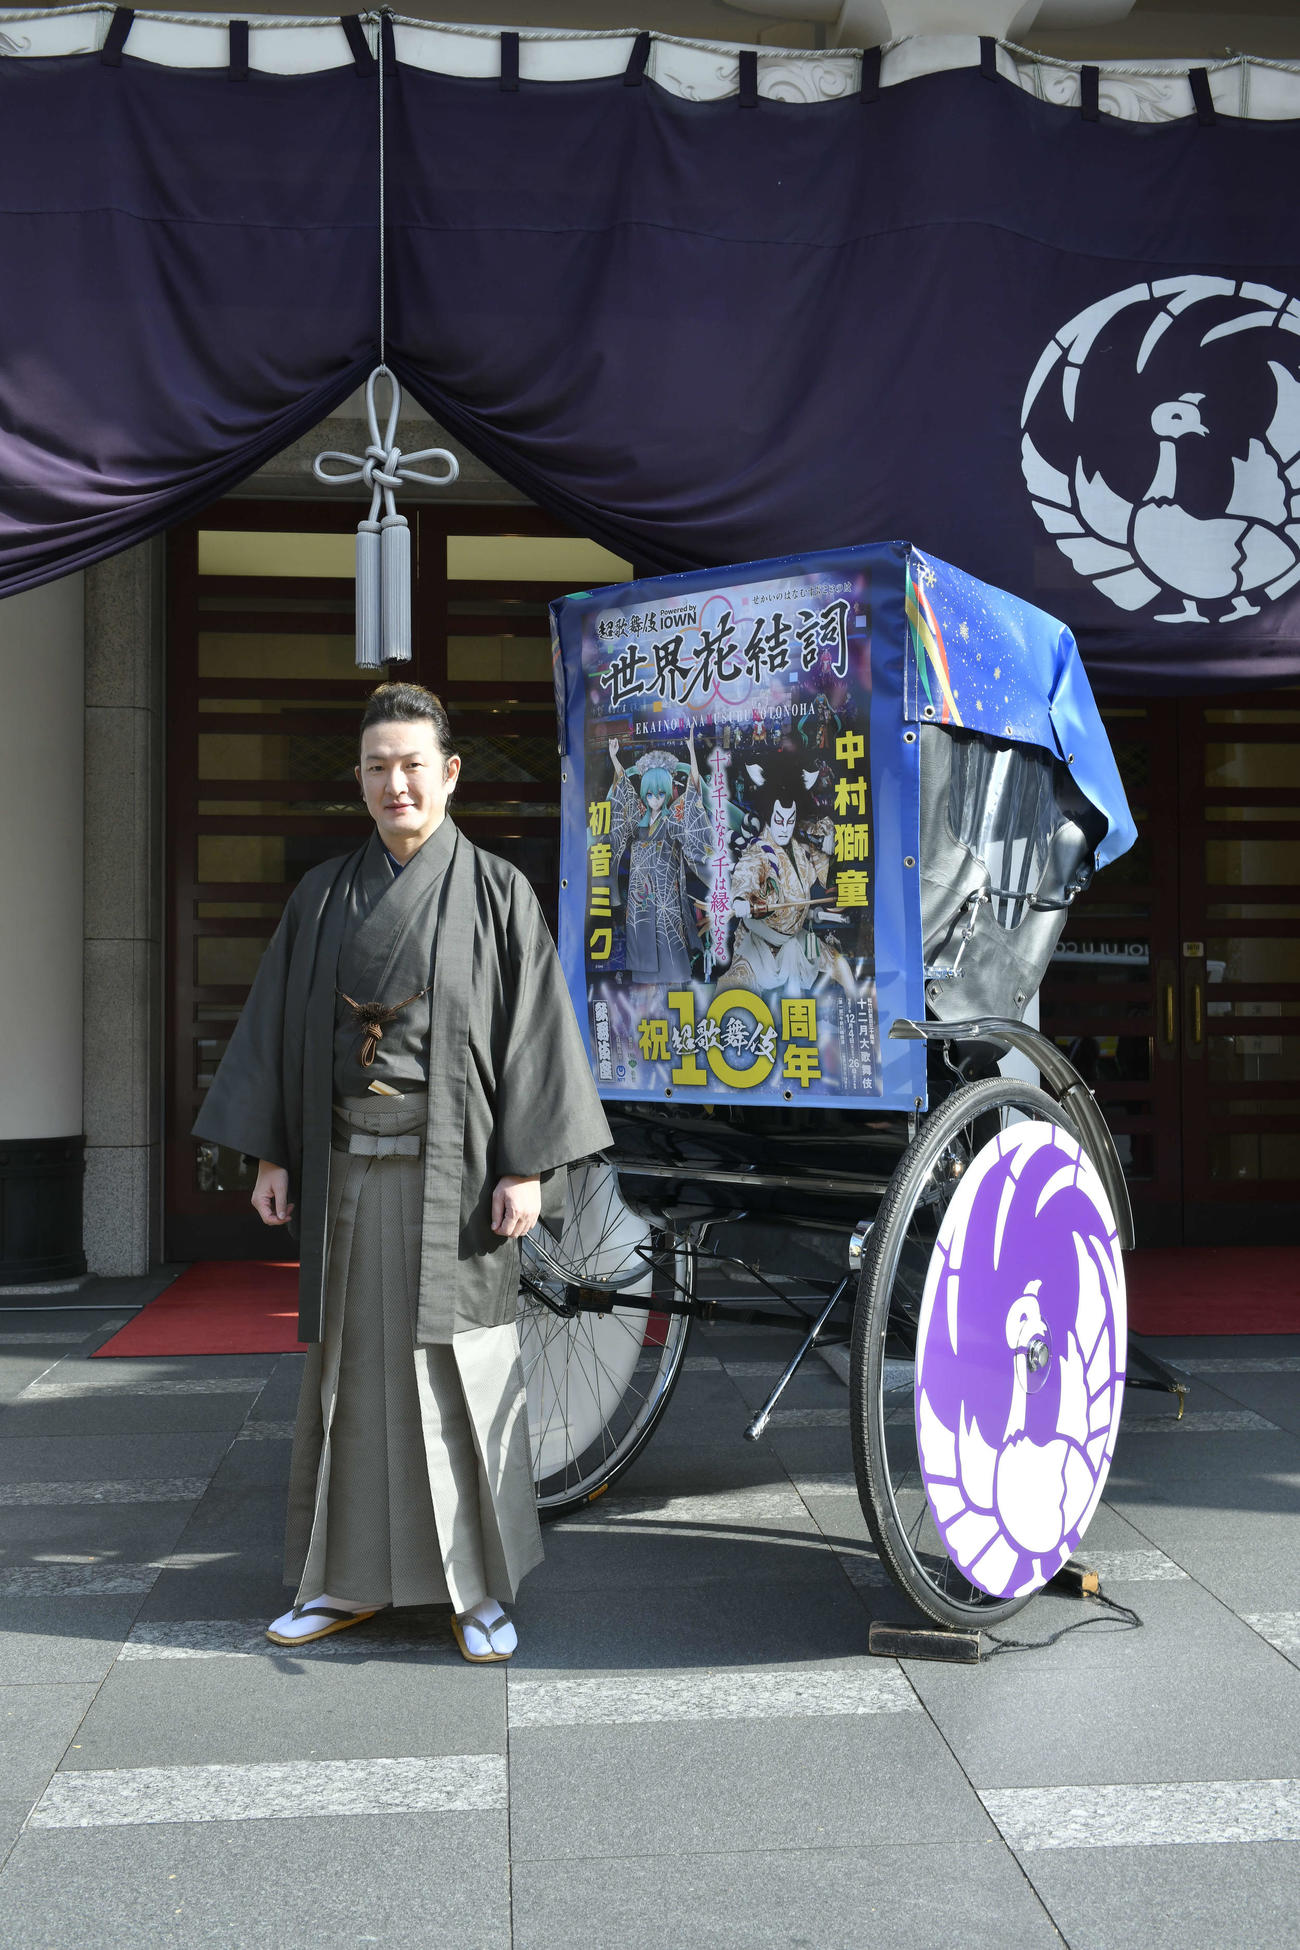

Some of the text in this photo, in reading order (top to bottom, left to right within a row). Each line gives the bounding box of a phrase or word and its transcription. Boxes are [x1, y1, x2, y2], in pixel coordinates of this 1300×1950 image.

[598, 612, 658, 640] 超歌舞伎
[660, 604, 697, 616] Powered by
[660, 611, 697, 630] IOWN
[601, 599, 849, 706] 世界花結詞
[833, 730, 869, 908] 中村獅童
[588, 801, 613, 961] 初音ミク
[638, 1019, 670, 1061] 祝
[671, 1017, 778, 1063] 超歌舞伎
[780, 998, 822, 1088] 周年
[857, 998, 873, 1089] 十二月大歌舞伎
